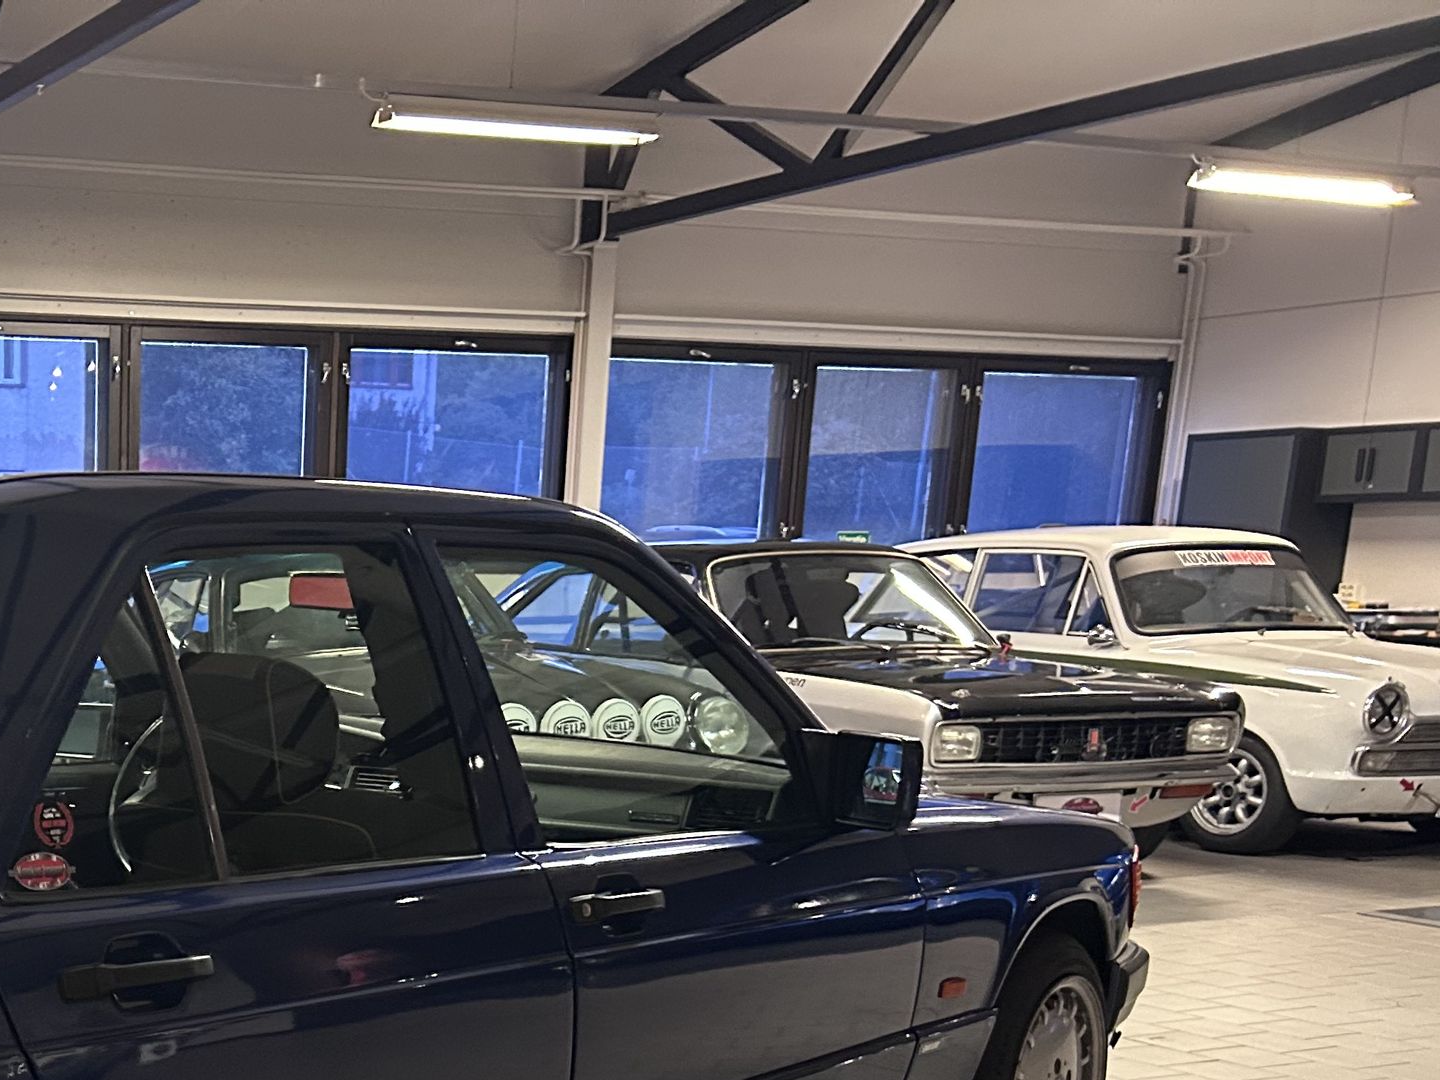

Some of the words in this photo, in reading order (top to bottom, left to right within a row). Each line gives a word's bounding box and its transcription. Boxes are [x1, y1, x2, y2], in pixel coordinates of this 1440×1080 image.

[556, 722, 587, 736] HELLA
[605, 720, 635, 731] HELLA
[652, 717, 681, 729] HELLA
